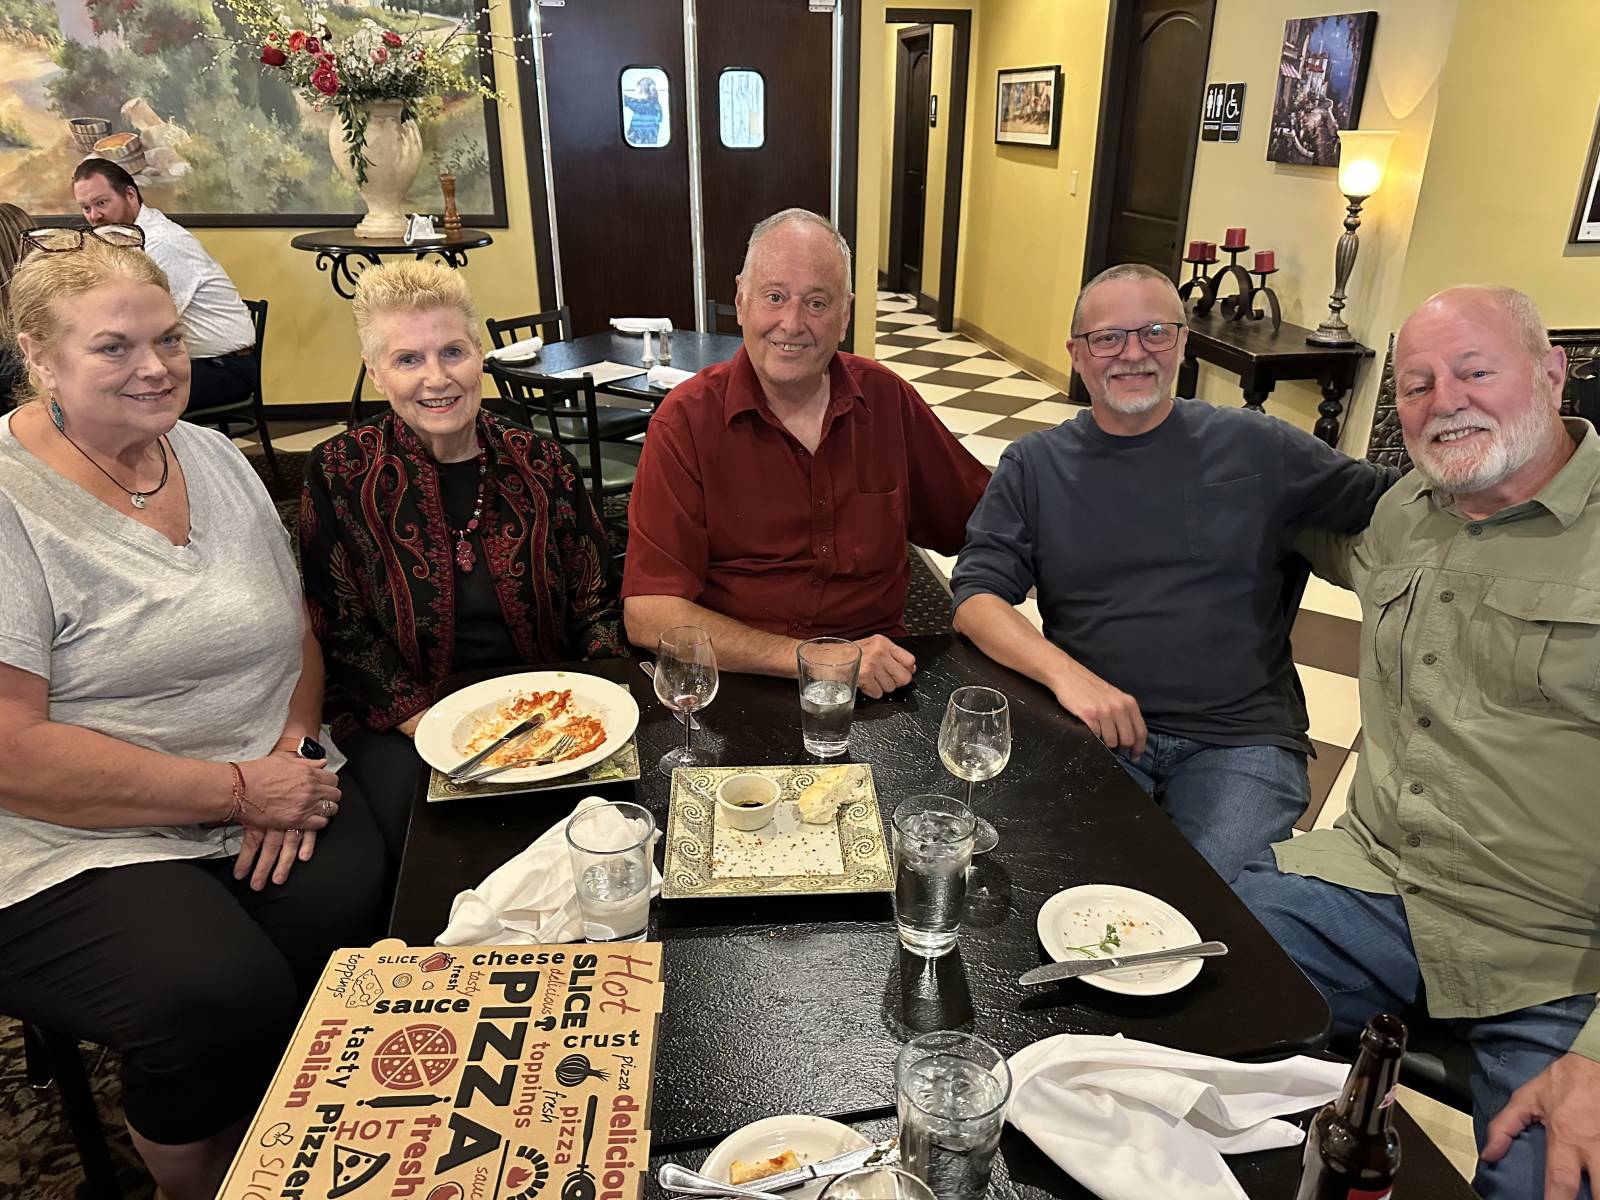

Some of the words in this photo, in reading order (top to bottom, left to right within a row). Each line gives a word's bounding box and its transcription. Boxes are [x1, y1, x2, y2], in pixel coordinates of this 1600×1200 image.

[327, 954, 365, 998] toppings
[377, 955, 420, 964] SLICE
[446, 964, 465, 991] fresh
[472, 951, 565, 965] cheese
[373, 998, 470, 1014] sauce
[456, 971, 485, 997] tasty
[541, 968, 567, 1016] delicious
[560, 954, 598, 1029] SLICE
[599, 955, 653, 1014] Hot
[326, 1025, 374, 1088] tasty
[563, 1029, 640, 1048] crust
[284, 1019, 348, 1108] Italian
[434, 970, 541, 1176] PIZZA
[513, 1041, 551, 1128] toppings
[611, 1053, 637, 1090] pizza
[540, 1090, 567, 1123] fresh
[334, 1119, 405, 1141] HOT
[554, 1106, 582, 1164] pizza
[391, 1114, 442, 1197] fresh
